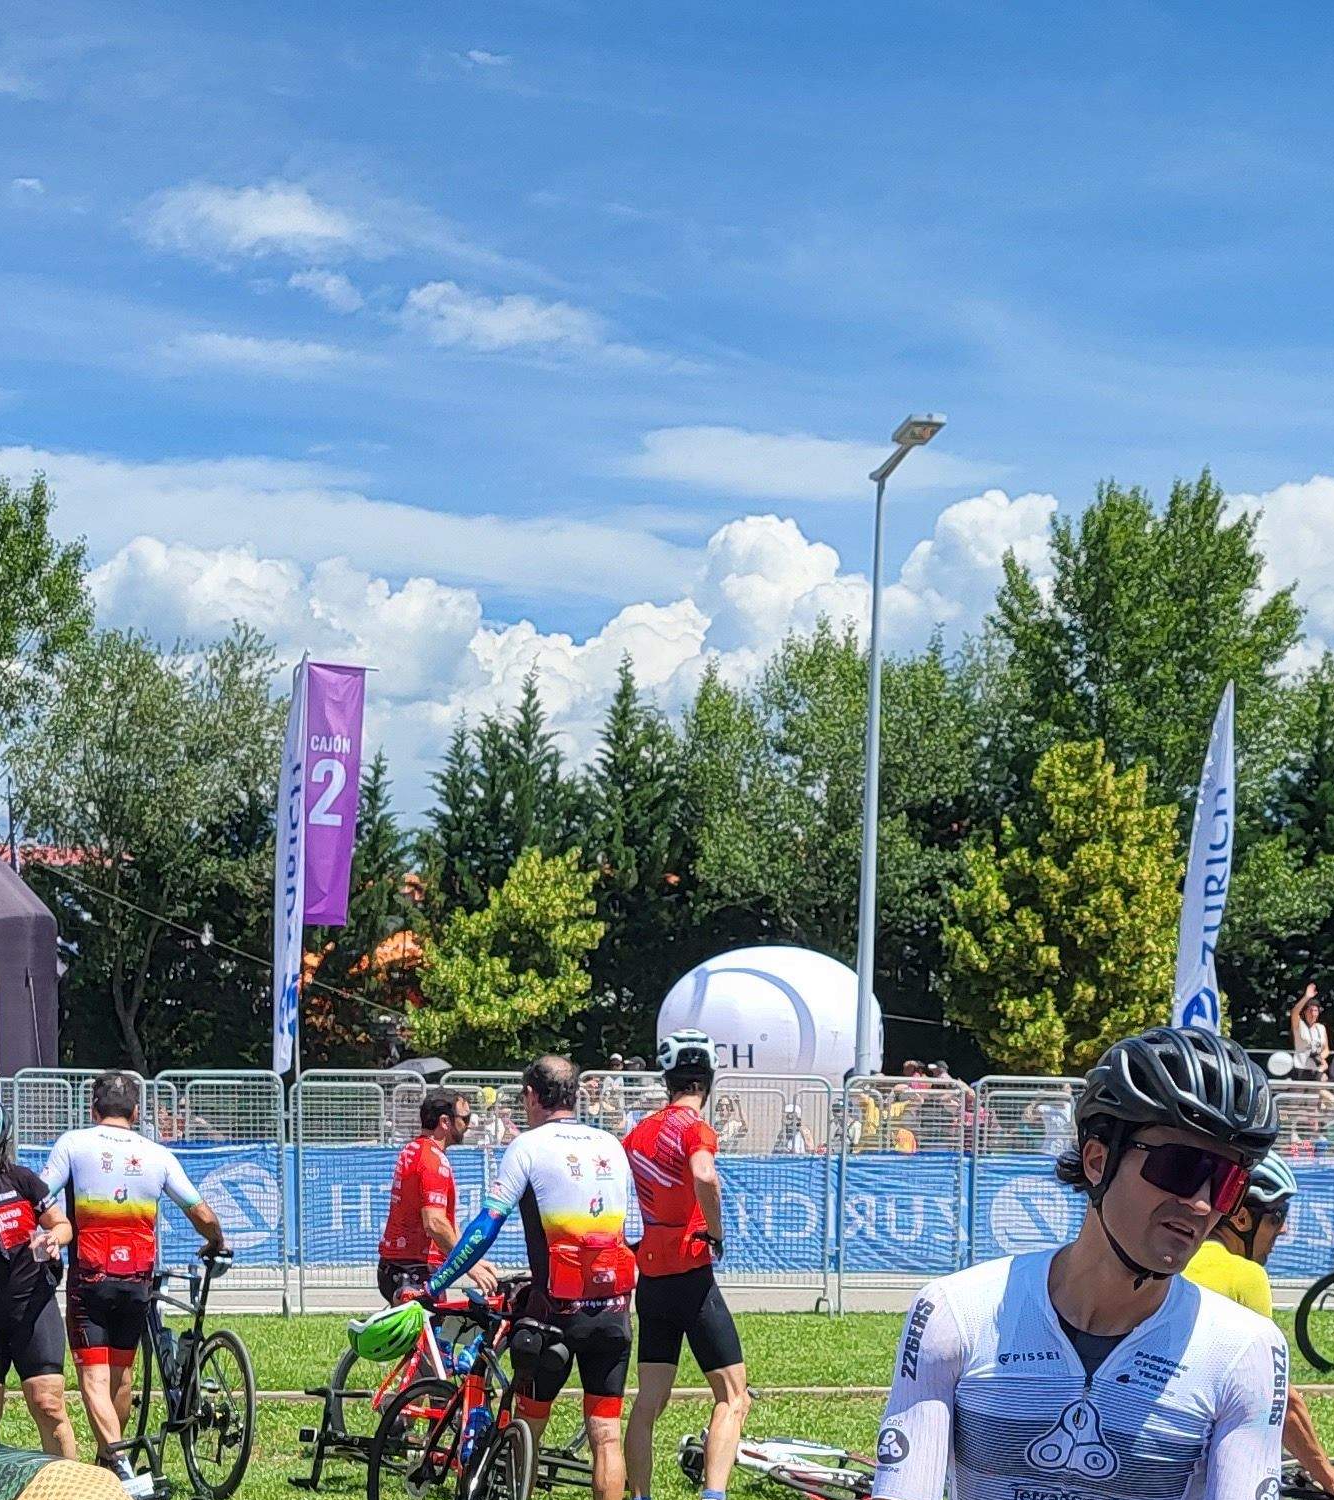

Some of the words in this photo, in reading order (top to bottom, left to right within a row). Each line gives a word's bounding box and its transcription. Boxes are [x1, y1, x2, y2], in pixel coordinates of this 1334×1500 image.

[310, 733, 352, 755] CAJÓN
[308, 758, 348, 828] 2
[901, 1297, 936, 1383] 226ERS
[1012, 1351, 1061, 1363] PISSEI
[1269, 1344, 1287, 1427] 226ERS
